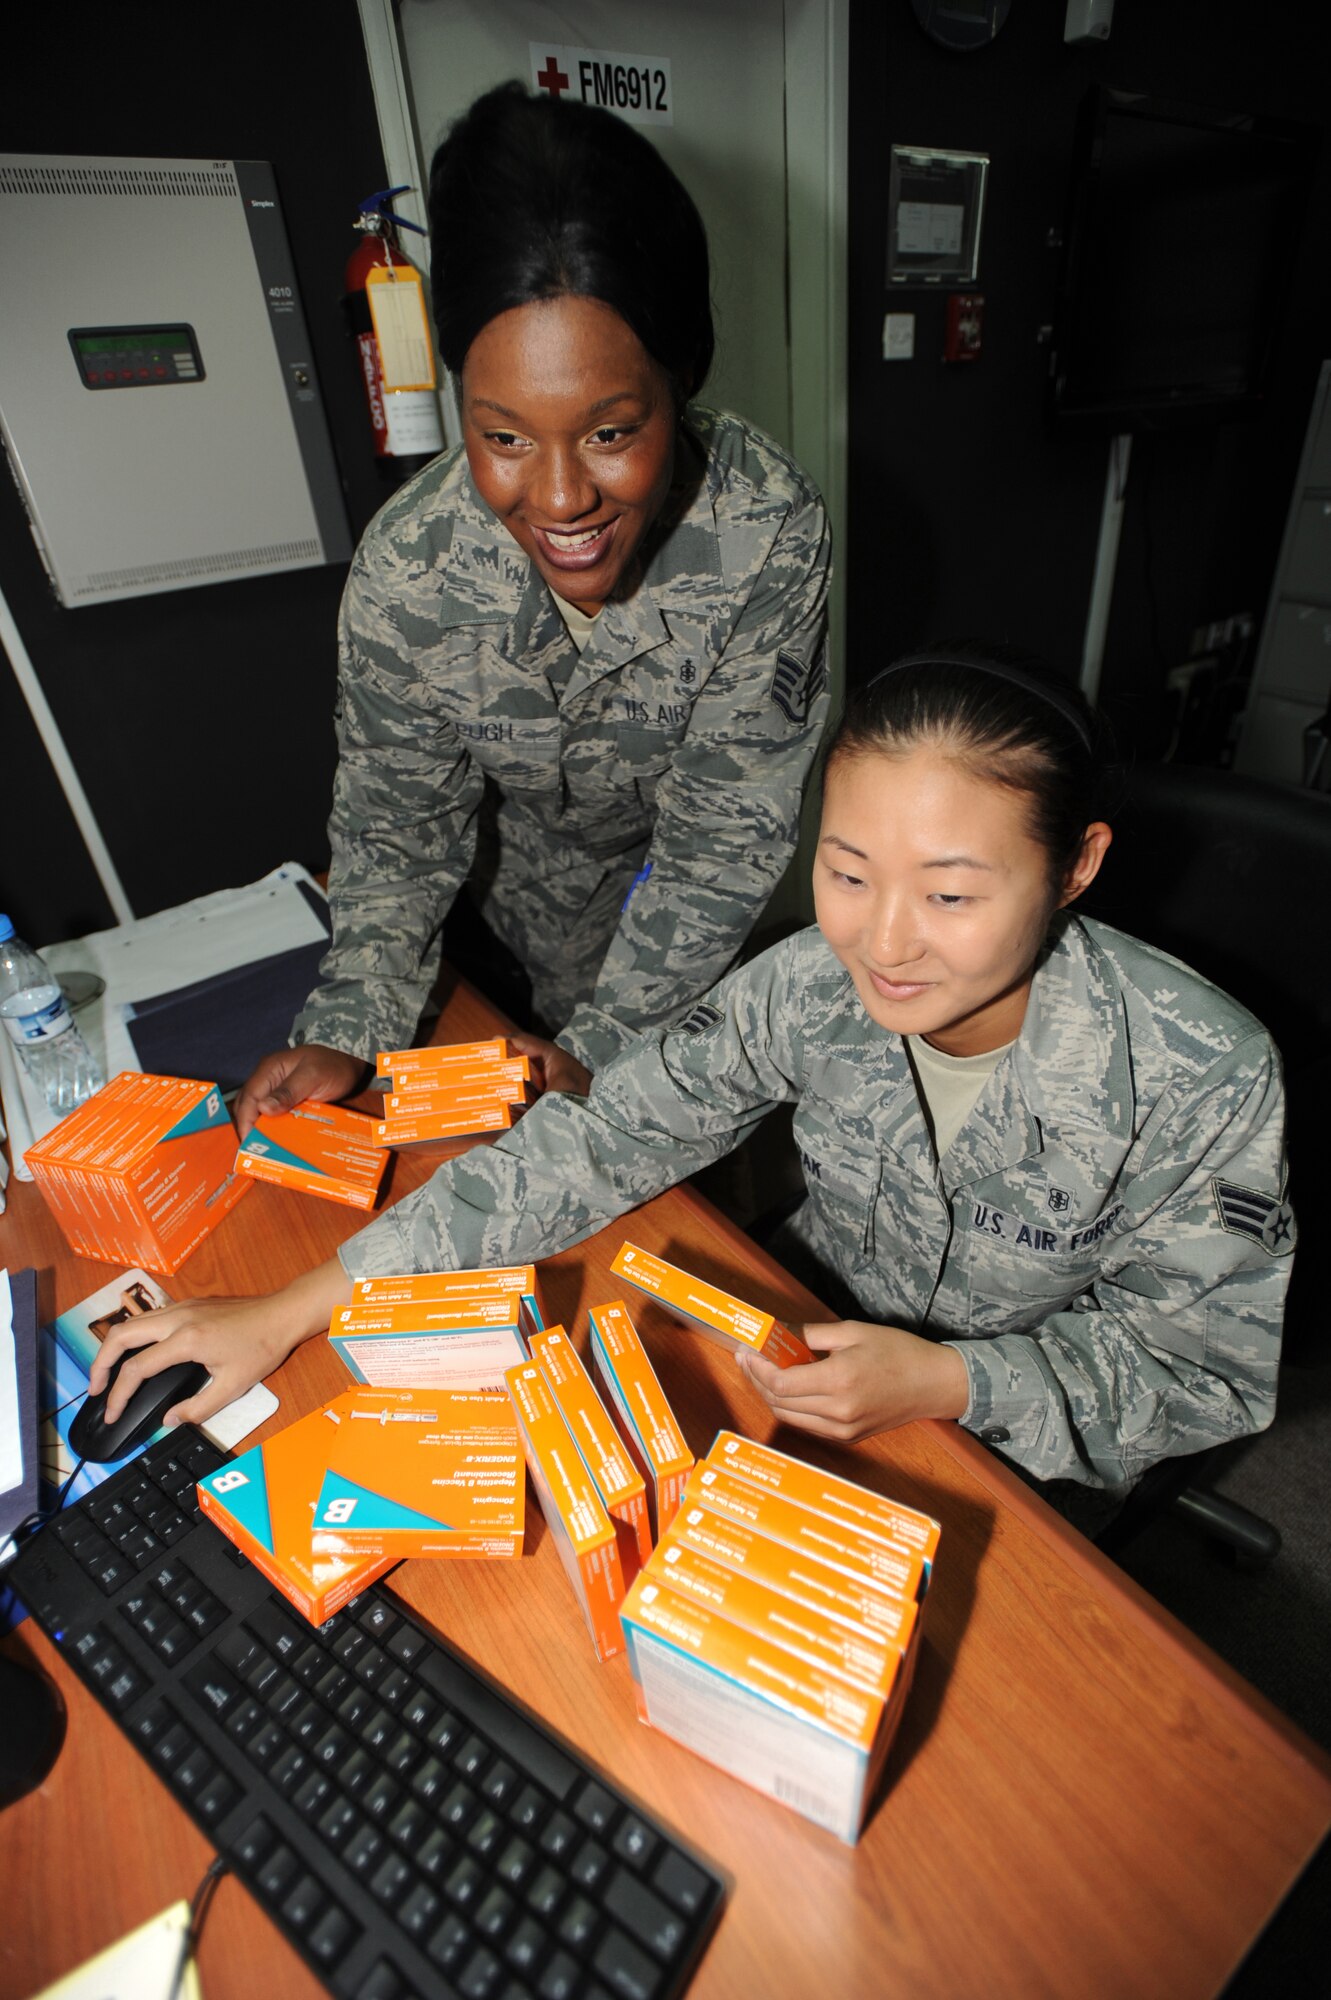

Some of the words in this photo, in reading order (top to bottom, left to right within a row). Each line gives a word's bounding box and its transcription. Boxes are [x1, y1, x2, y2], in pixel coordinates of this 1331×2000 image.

[578, 60, 668, 111] FM6912
[268, 286, 292, 298] 4010
[626, 699, 651, 721] U.S.
[658, 705, 688, 723] AIR
[205, 1092, 220, 1119] B
[245, 1142, 270, 1155] B
[974, 1204, 1006, 1239] U.S.
[1015, 1230, 1058, 1250] AIR
[623, 1251, 636, 1263] B
[361, 1282, 373, 1293] B
[339, 1310, 352, 1322] B
[608, 1309, 622, 1318] B
[547, 1334, 561, 1345] B
[522, 1368, 537, 1380] B
[724, 1441, 740, 1454] B
[211, 1470, 251, 1494] B
[431, 1478, 466, 1487] Vaccine
[468, 1479, 475, 1487] B
[476, 1478, 516, 1487] Hepatitis
[700, 1471, 717, 1486] B
[472, 1496, 515, 1504] 20mcg/mL
[322, 1497, 358, 1523] B
[686, 1509, 704, 1526] B
[664, 1547, 682, 1564] B
